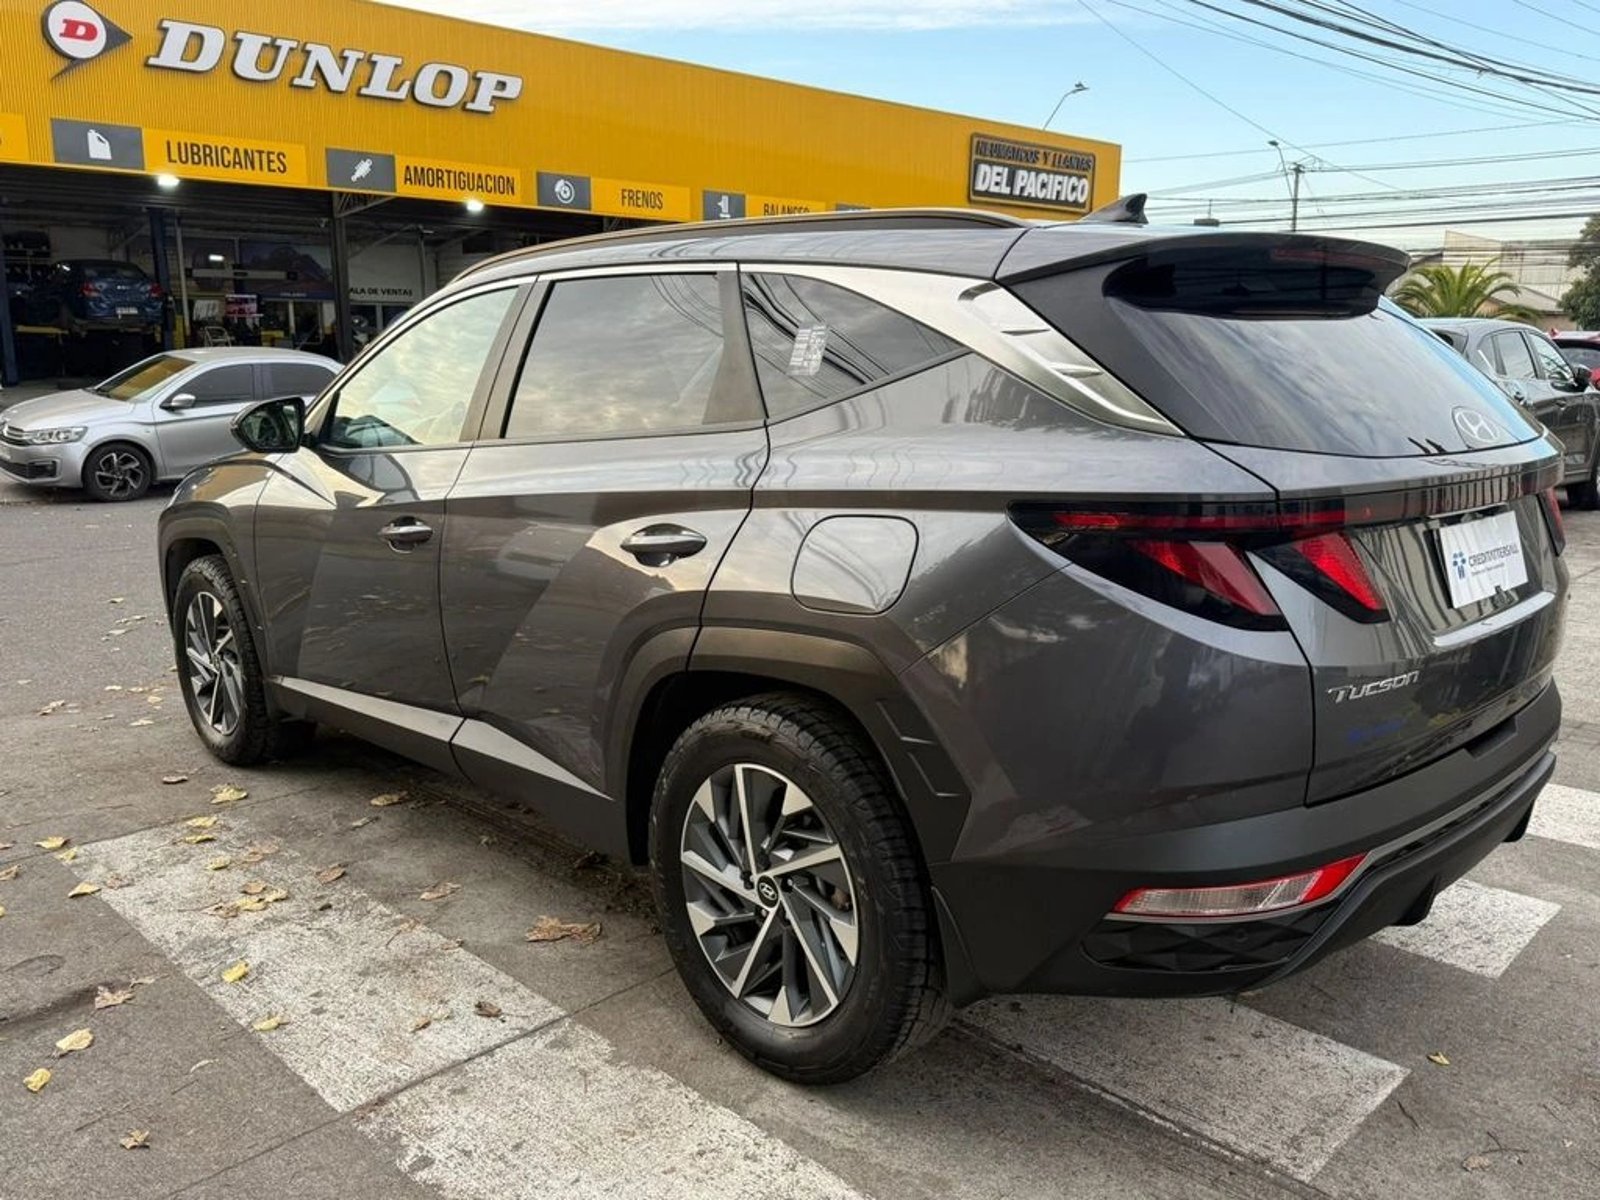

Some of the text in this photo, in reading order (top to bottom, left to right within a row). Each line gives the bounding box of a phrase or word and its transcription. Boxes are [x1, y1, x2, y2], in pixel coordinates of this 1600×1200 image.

[59, 19, 98, 42] D
[146, 19, 523, 113] DUNLOP
[166, 140, 287, 174] LUBRICANTES
[1040, 150, 1051, 164] Y
[404, 165, 515, 196] AMORTIGUACION
[974, 163, 1089, 203] DEL PACIFICO
[621, 188, 663, 210] FRENOS
[367, 287, 379, 295] DE
[381, 288, 413, 296] VENTAS
[1327, 670, 1419, 704] TUCSON
